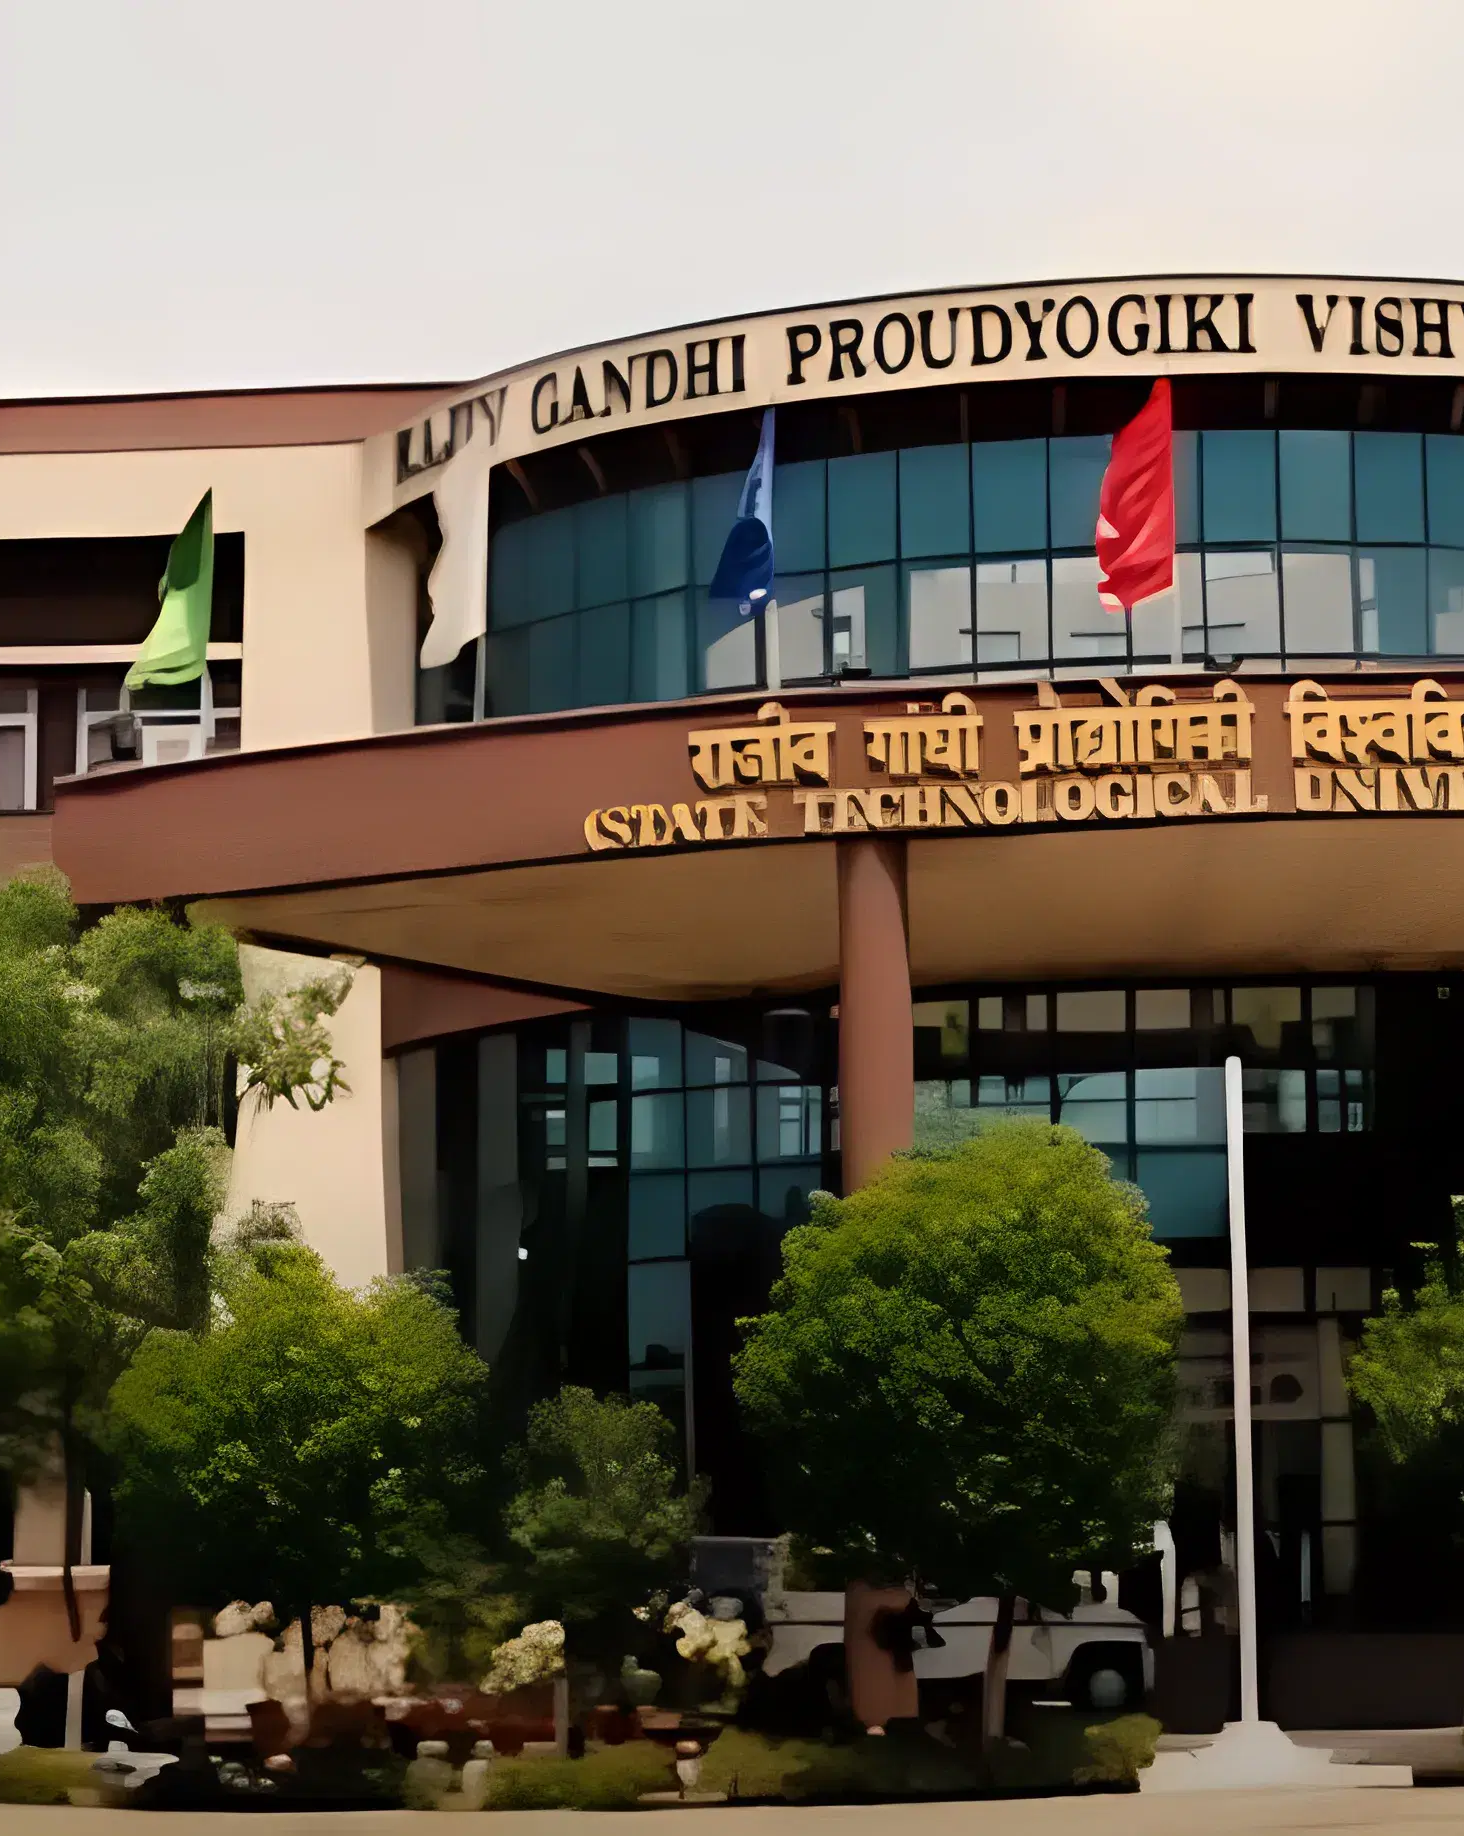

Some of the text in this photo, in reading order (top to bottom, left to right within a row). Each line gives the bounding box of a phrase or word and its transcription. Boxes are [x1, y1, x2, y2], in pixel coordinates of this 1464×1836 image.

[531, 334, 746, 436] GANDHI
[785, 294, 1256, 386] PROUDYOGIKI
[688, 702, 836, 790] राजीव
[793, 768, 1269, 834] TECHNOLOGICAL
